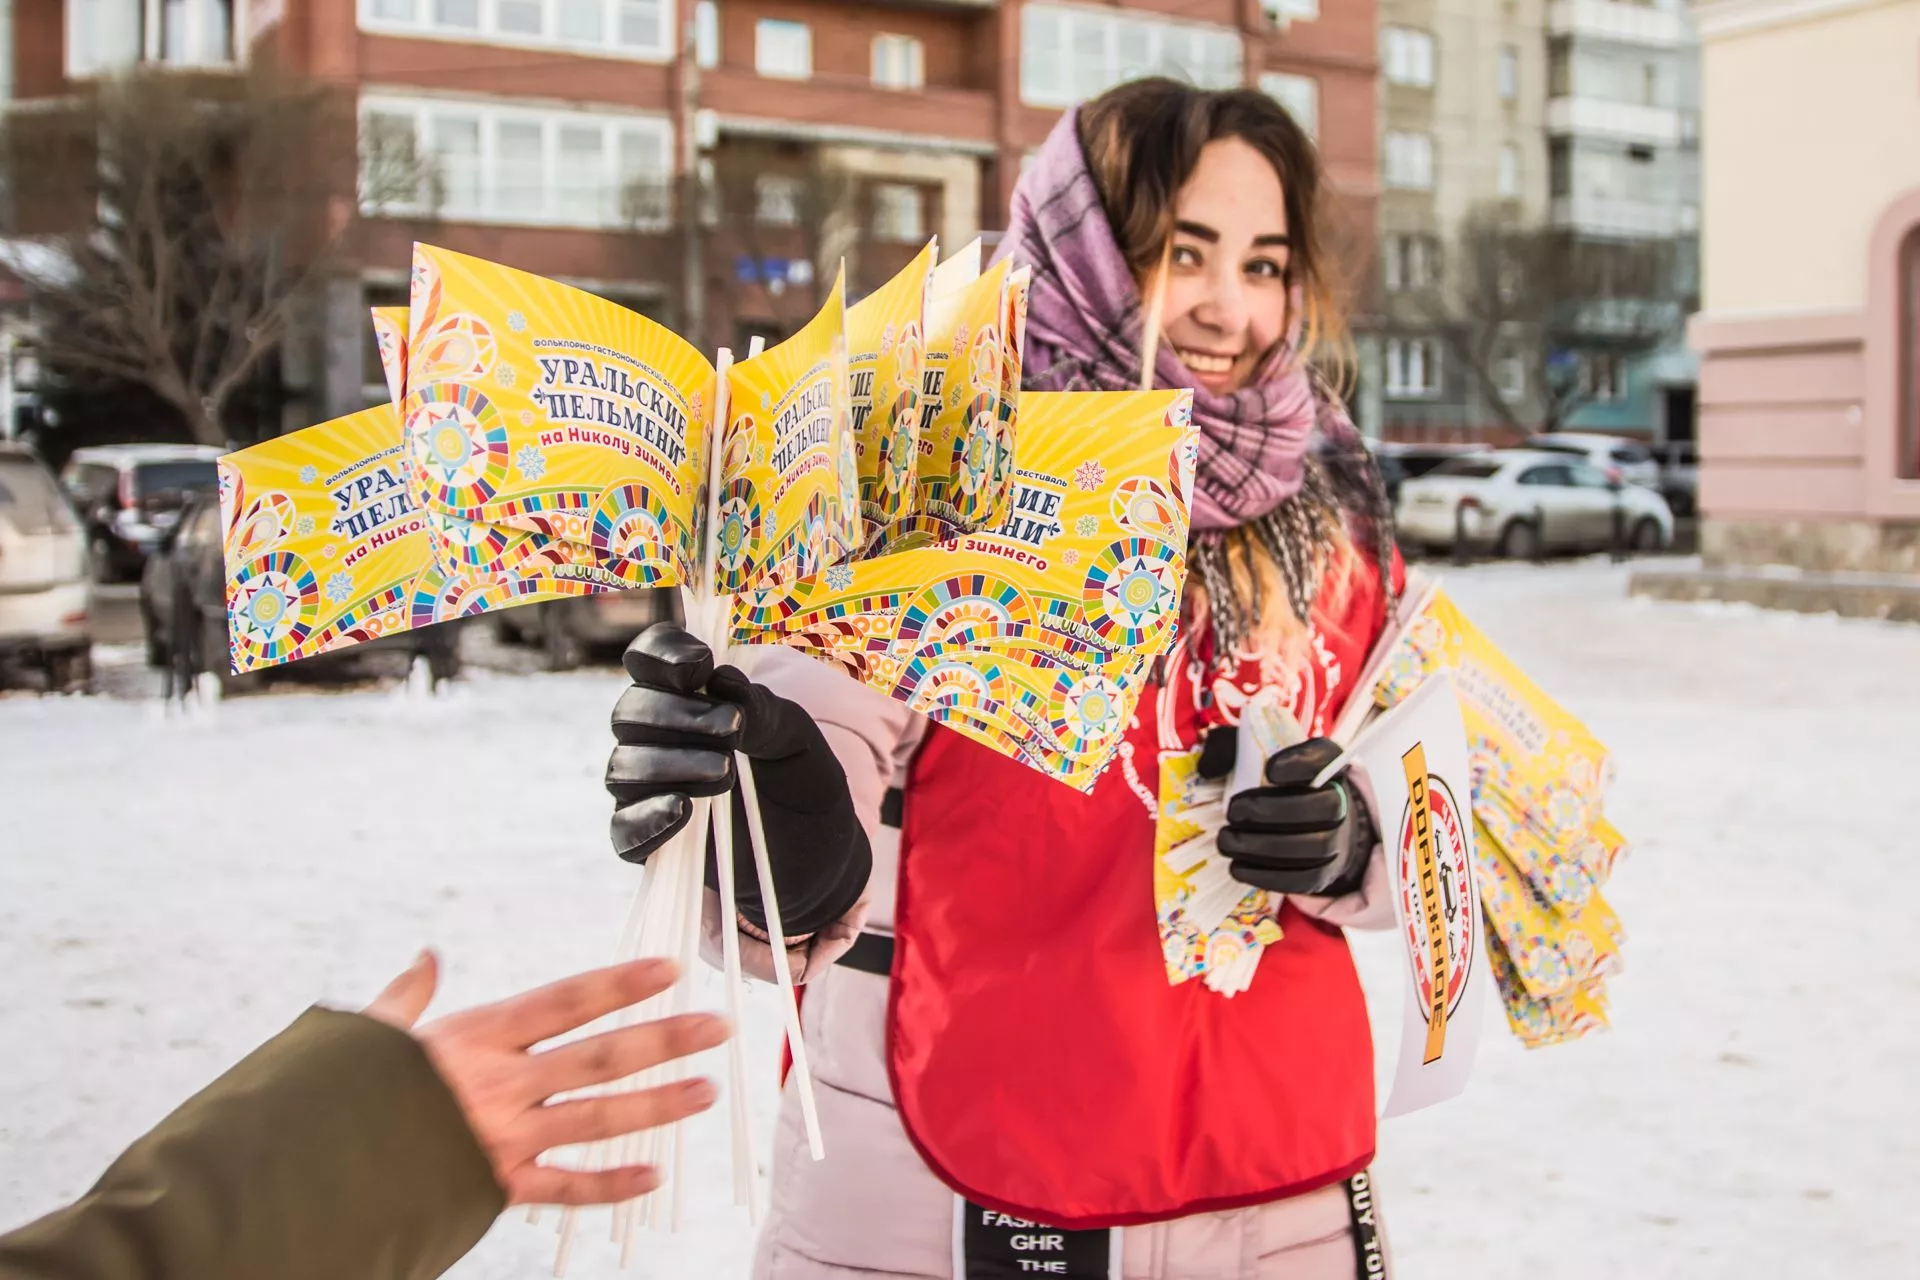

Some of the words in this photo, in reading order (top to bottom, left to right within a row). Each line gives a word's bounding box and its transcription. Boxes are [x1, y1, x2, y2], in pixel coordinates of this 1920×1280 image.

[540, 358, 687, 441] УРАЛЬСКИЕ
[543, 393, 684, 467] ПЕЛЬМЕНИ
[541, 430, 564, 447] на
[568, 427, 631, 456] Николу
[634, 444, 682, 496] зимнего
[1015, 469, 1068, 488] ФЕСТИВАЛЬ
[1015, 486, 1061, 518] ИЕ
[345, 545, 368, 567] на
[370, 519, 427, 549] Нико
[965, 539, 1048, 571] зимнего
[1009, 1234, 1065, 1251] GHR
[1016, 1259, 1069, 1275] THE
